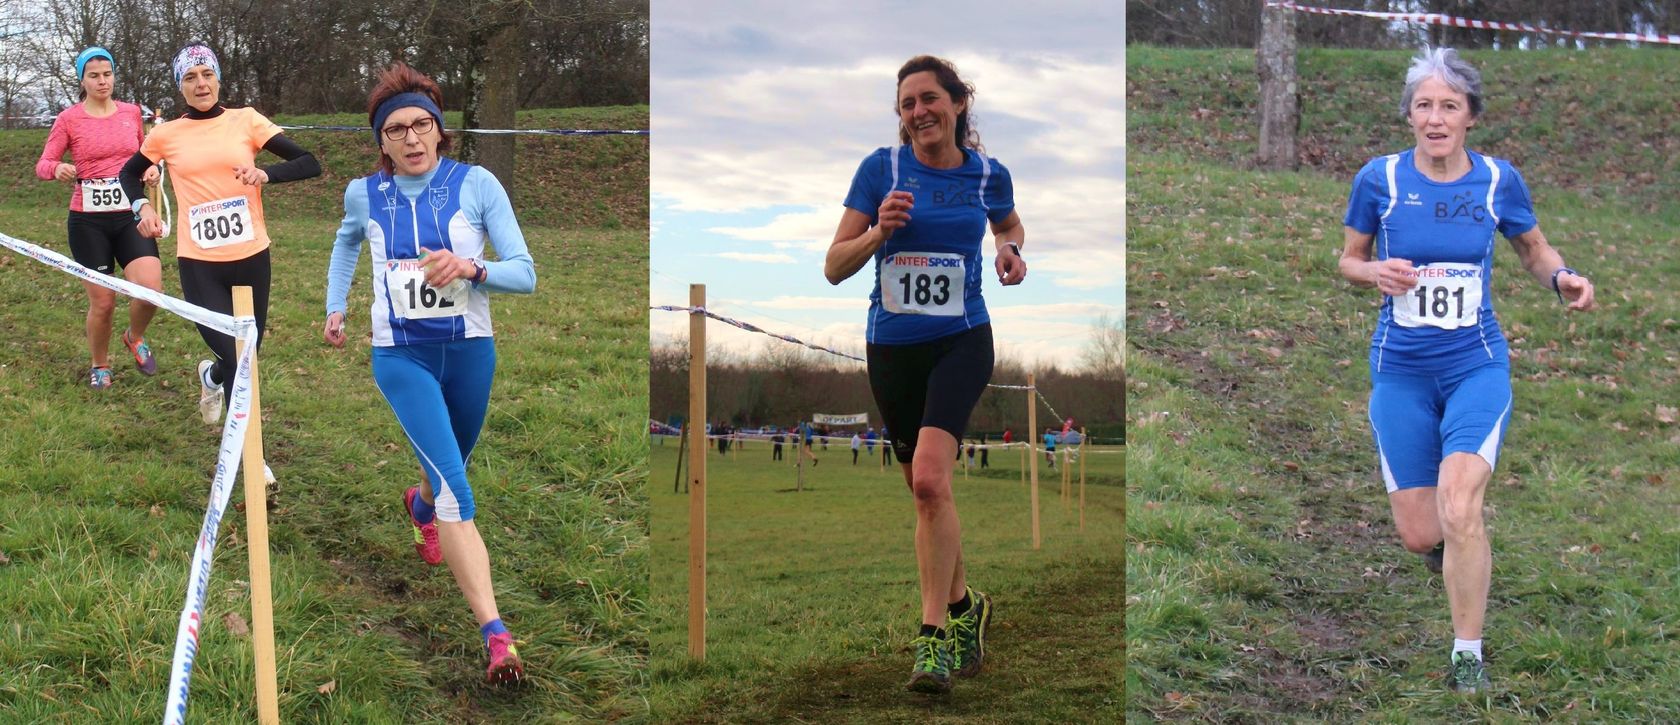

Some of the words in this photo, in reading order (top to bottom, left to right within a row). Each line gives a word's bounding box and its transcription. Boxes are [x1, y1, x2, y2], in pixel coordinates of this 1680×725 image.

[92, 187, 122, 206] 559
[198, 198, 246, 215] INTERSPORT
[1435, 202, 1486, 222] BAC
[192, 212, 244, 241] 1803
[895, 256, 961, 268] INTERSPORT
[899, 272, 950, 306] 183
[1414, 285, 1465, 319] 181
